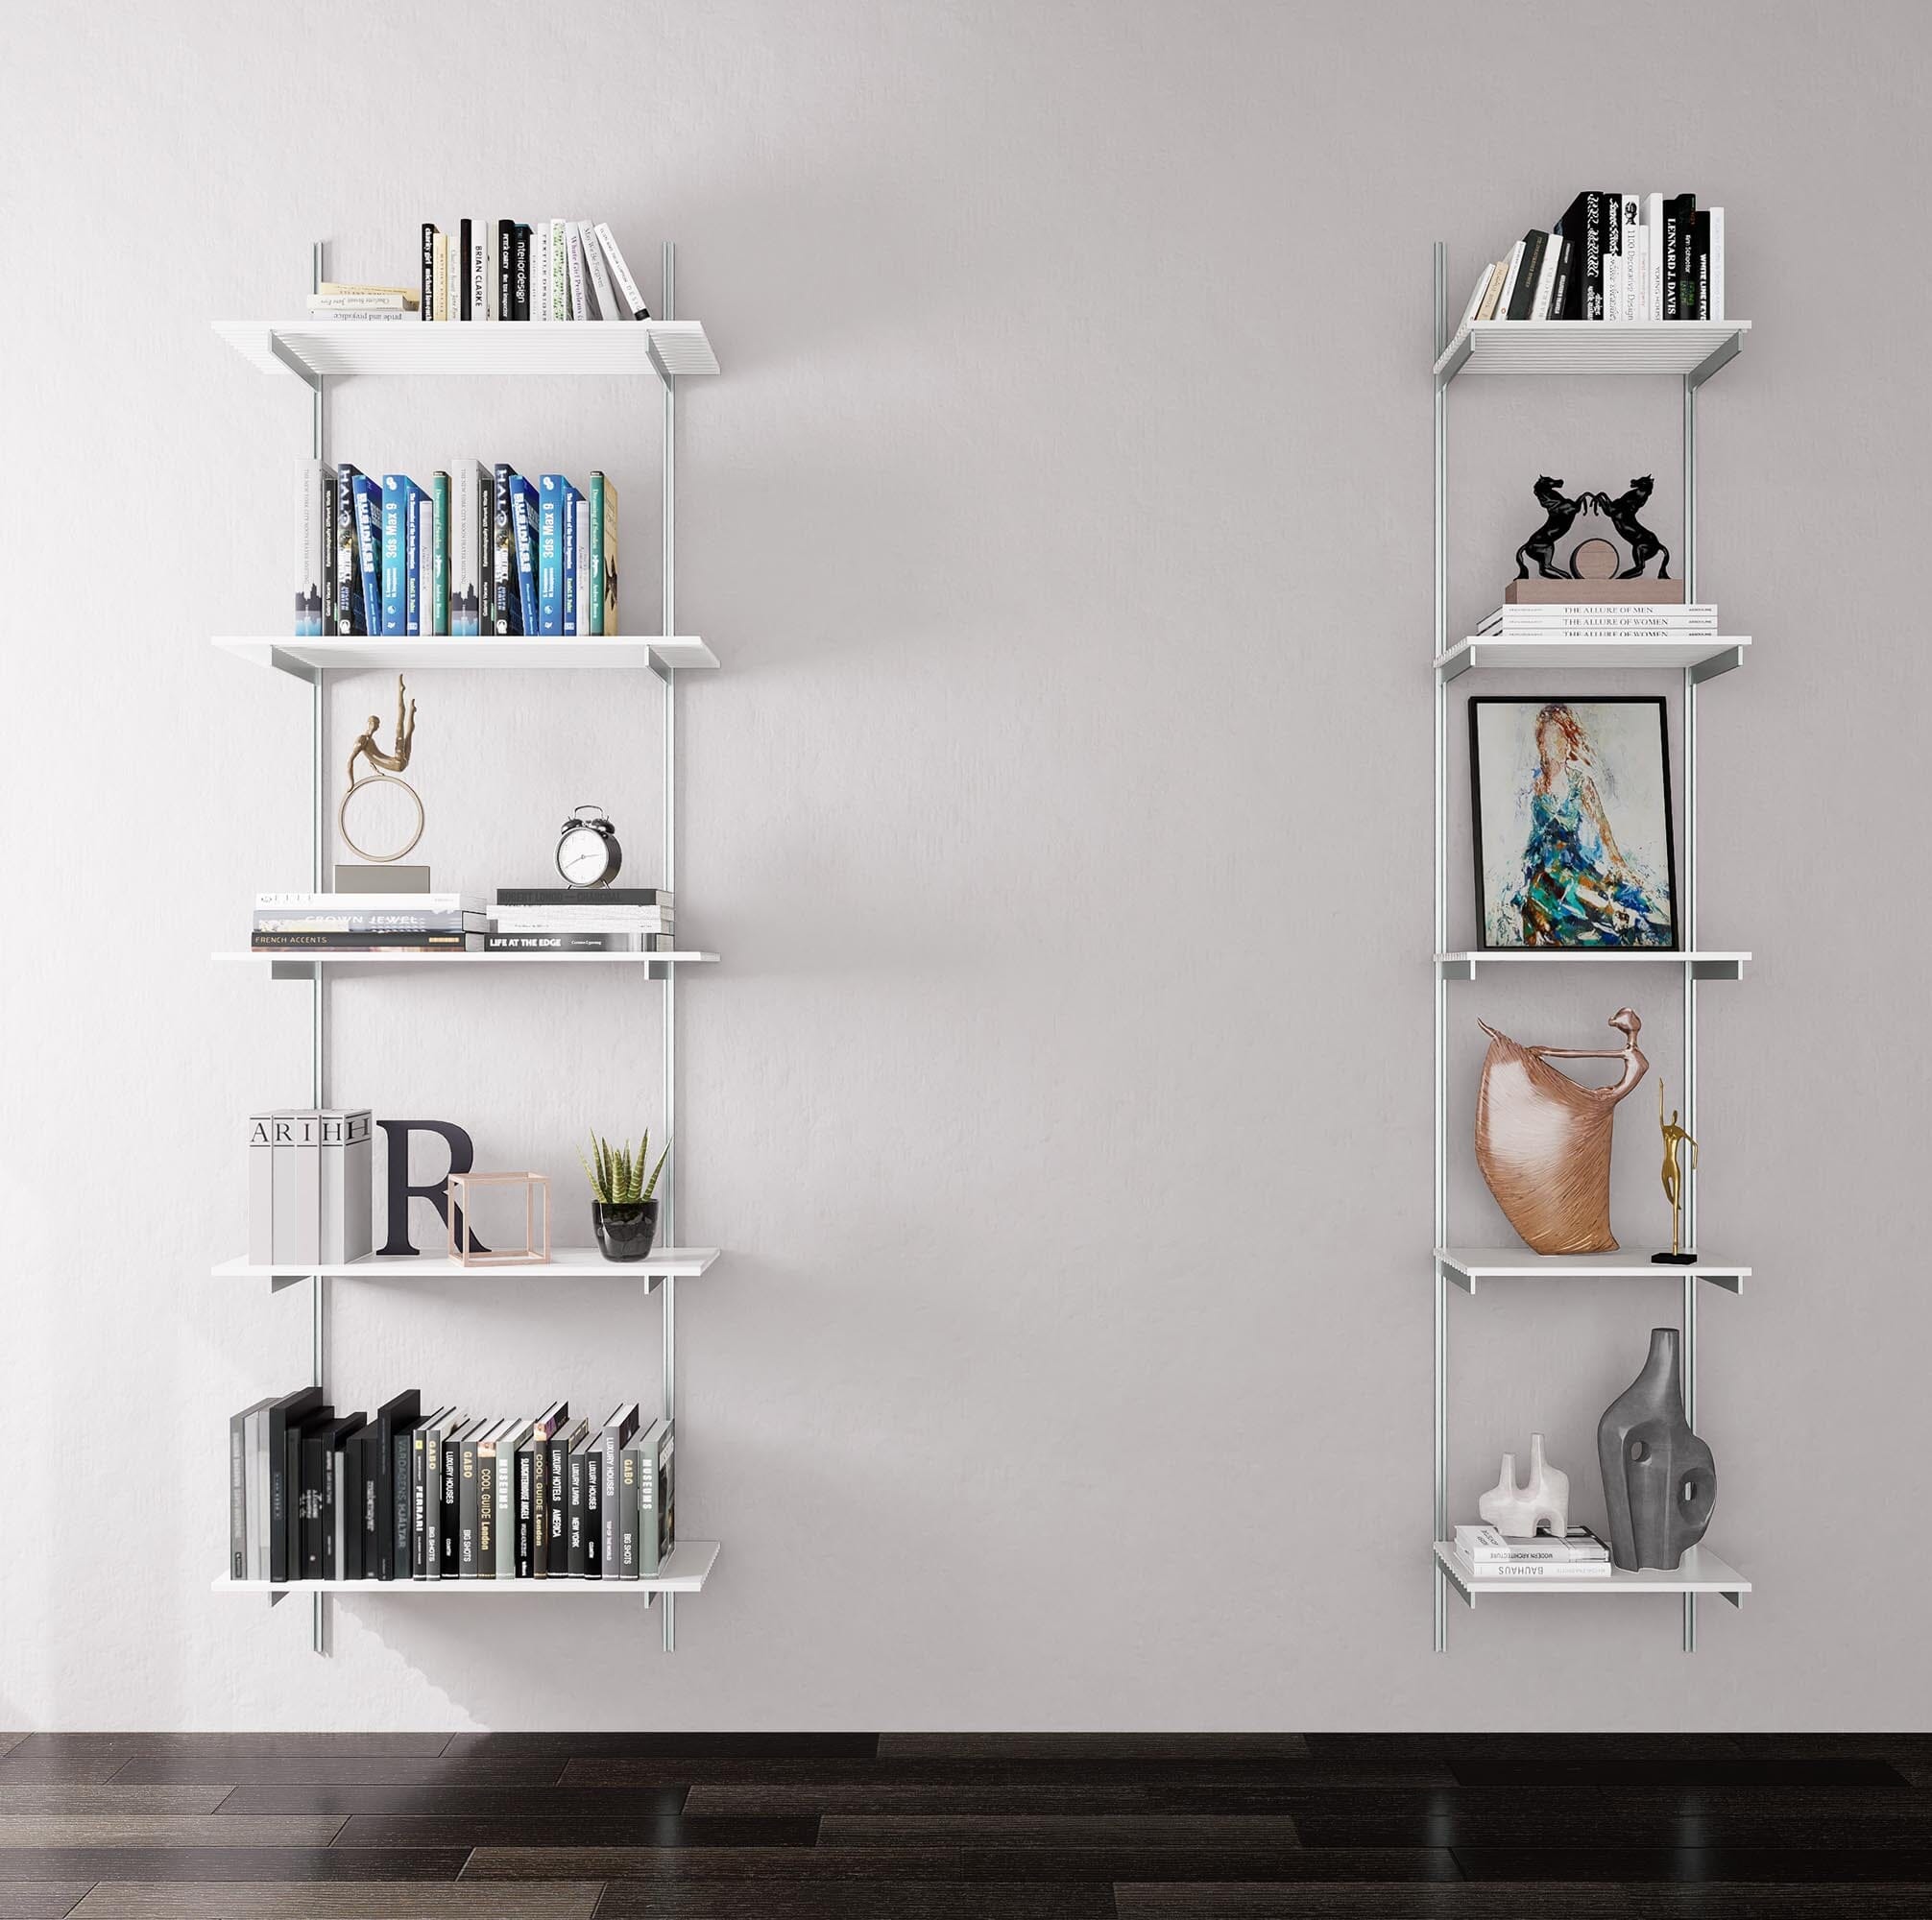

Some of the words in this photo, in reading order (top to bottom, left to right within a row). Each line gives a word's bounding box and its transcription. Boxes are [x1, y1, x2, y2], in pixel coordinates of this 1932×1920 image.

[516, 272, 526, 303] design
[1668, 271, 1676, 280] J.
[1625, 294, 1635, 321] Design
[339, 469, 350, 527] HALO
[495, 469, 507, 527] HALO
[356, 492, 374, 573] BUSINESS
[386, 513, 397, 536] Max
[514, 492, 531, 573] BUSINESS
[543, 513, 554, 536] Max
[386, 539, 397, 558] 3ds
[543, 539, 554, 558] 3ds
[376, 1119, 492, 1256] R
[446, 1451, 454, 1476] LUXURY
[552, 1450, 562, 1475] LUXURY
[606, 1437, 615, 1465] LUXURY
[463, 1451, 472, 1478] GABO
[571, 1463, 580, 1486] LUXURY
[624, 1459, 633, 1485] GABO
[446, 1477, 454, 1504] HOUSES
[481, 1468, 491, 1491] COOL
[498, 1458, 508, 1509] MUSEUMS
[552, 1476, 562, 1501] HOTELS
[606, 1466, 615, 1496] HOUSES
[642, 1459, 652, 1509] MUSEUMS
[481, 1494, 491, 1519] GUIDE
[571, 1486, 580, 1505] LIVING
[520, 1500, 529, 1520] ANGELS
[463, 1529, 471, 1540] BIG
[552, 1508, 562, 1538] AMERICA
[571, 1517, 580, 1530] NEW
[481, 1522, 491, 1550] London
[571, 1531, 580, 1548] YORK
[623, 1533, 632, 1544] BIG
[463, 1541, 471, 1562] SHOTS
[623, 1544, 632, 1565] SHOTS
[1498, 1566, 1544, 1575] BAUHAUS
